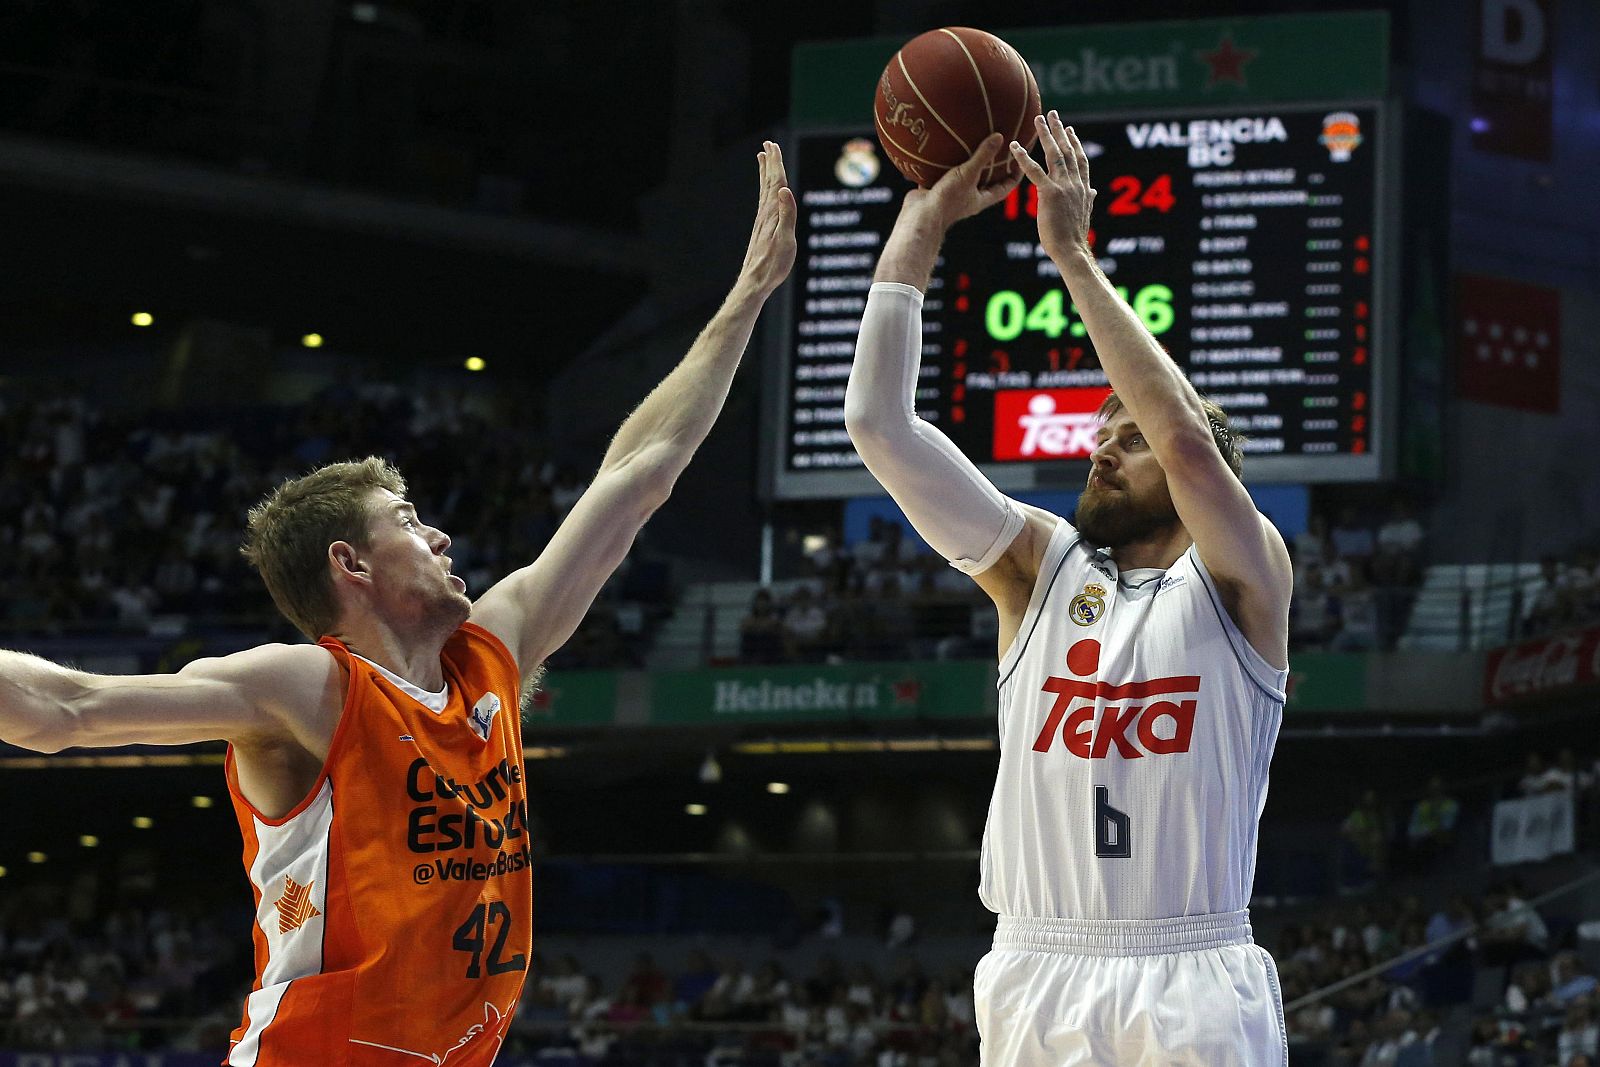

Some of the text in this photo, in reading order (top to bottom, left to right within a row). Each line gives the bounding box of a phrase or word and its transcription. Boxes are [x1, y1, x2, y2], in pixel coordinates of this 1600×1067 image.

[1125, 117, 1289, 149] VALENCIA
[1187, 142, 1235, 168] BC
[1107, 174, 1176, 216] 24
[985, 284, 1175, 341] 04:6
[1018, 412, 1098, 456] Tek
[714, 678, 878, 713] Heineken
[1094, 785, 1131, 858] 6
[453, 902, 526, 979] 42
